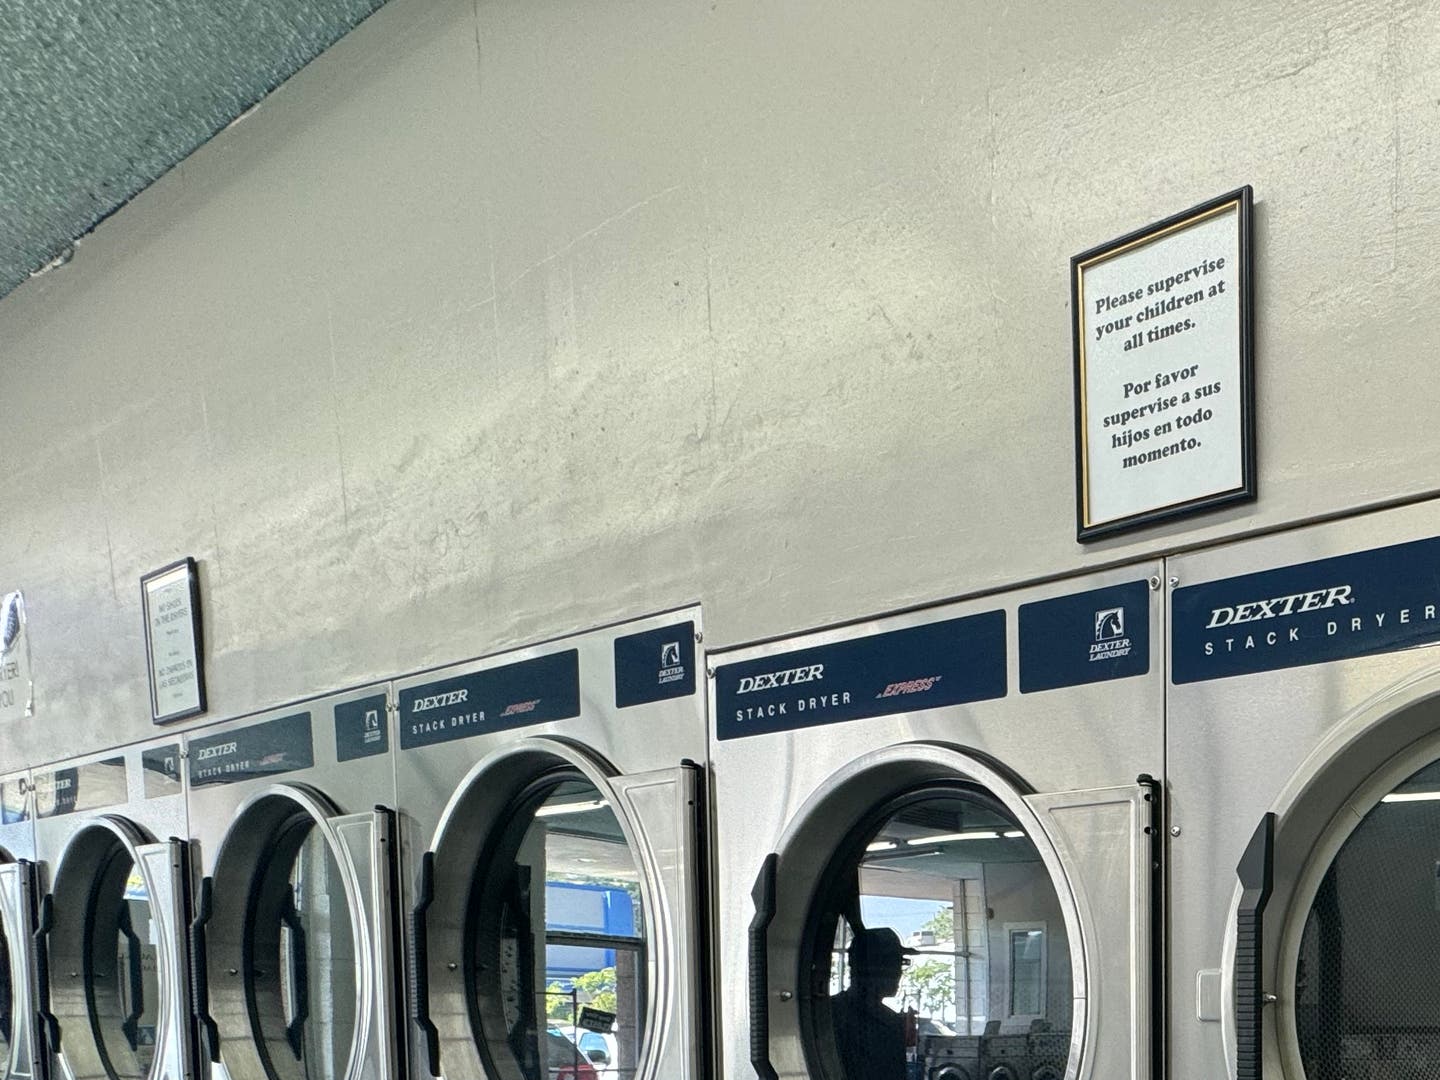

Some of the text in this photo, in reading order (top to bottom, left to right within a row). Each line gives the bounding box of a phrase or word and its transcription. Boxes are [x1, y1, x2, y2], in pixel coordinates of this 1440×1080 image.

[1095, 256, 1226, 315] Please supervise
[1095, 279, 1226, 340] your children at
[1123, 320, 1196, 352] all times.
[1123, 363, 1199, 398] Por favor
[1103, 379, 1222, 429] supervise a sus
[1111, 406, 1213, 449] hijos en todo
[1122, 439, 1202, 469] momento.
[1205, 584, 1352, 630] DEXTER
[1089, 639, 1130, 653] DEXTER
[1204, 605, 1436, 655] STACK DRYER
[1089, 647, 1131, 661] LAUNDRY
[736, 664, 824, 694] DEXTER
[412, 689, 468, 713] DEXTER
[736, 677, 936, 722] STACK DRYER EXPRESS
[412, 720, 445, 735] STACK
[451, 711, 485, 727] DRYER
[197, 742, 237, 760] DEXTER
